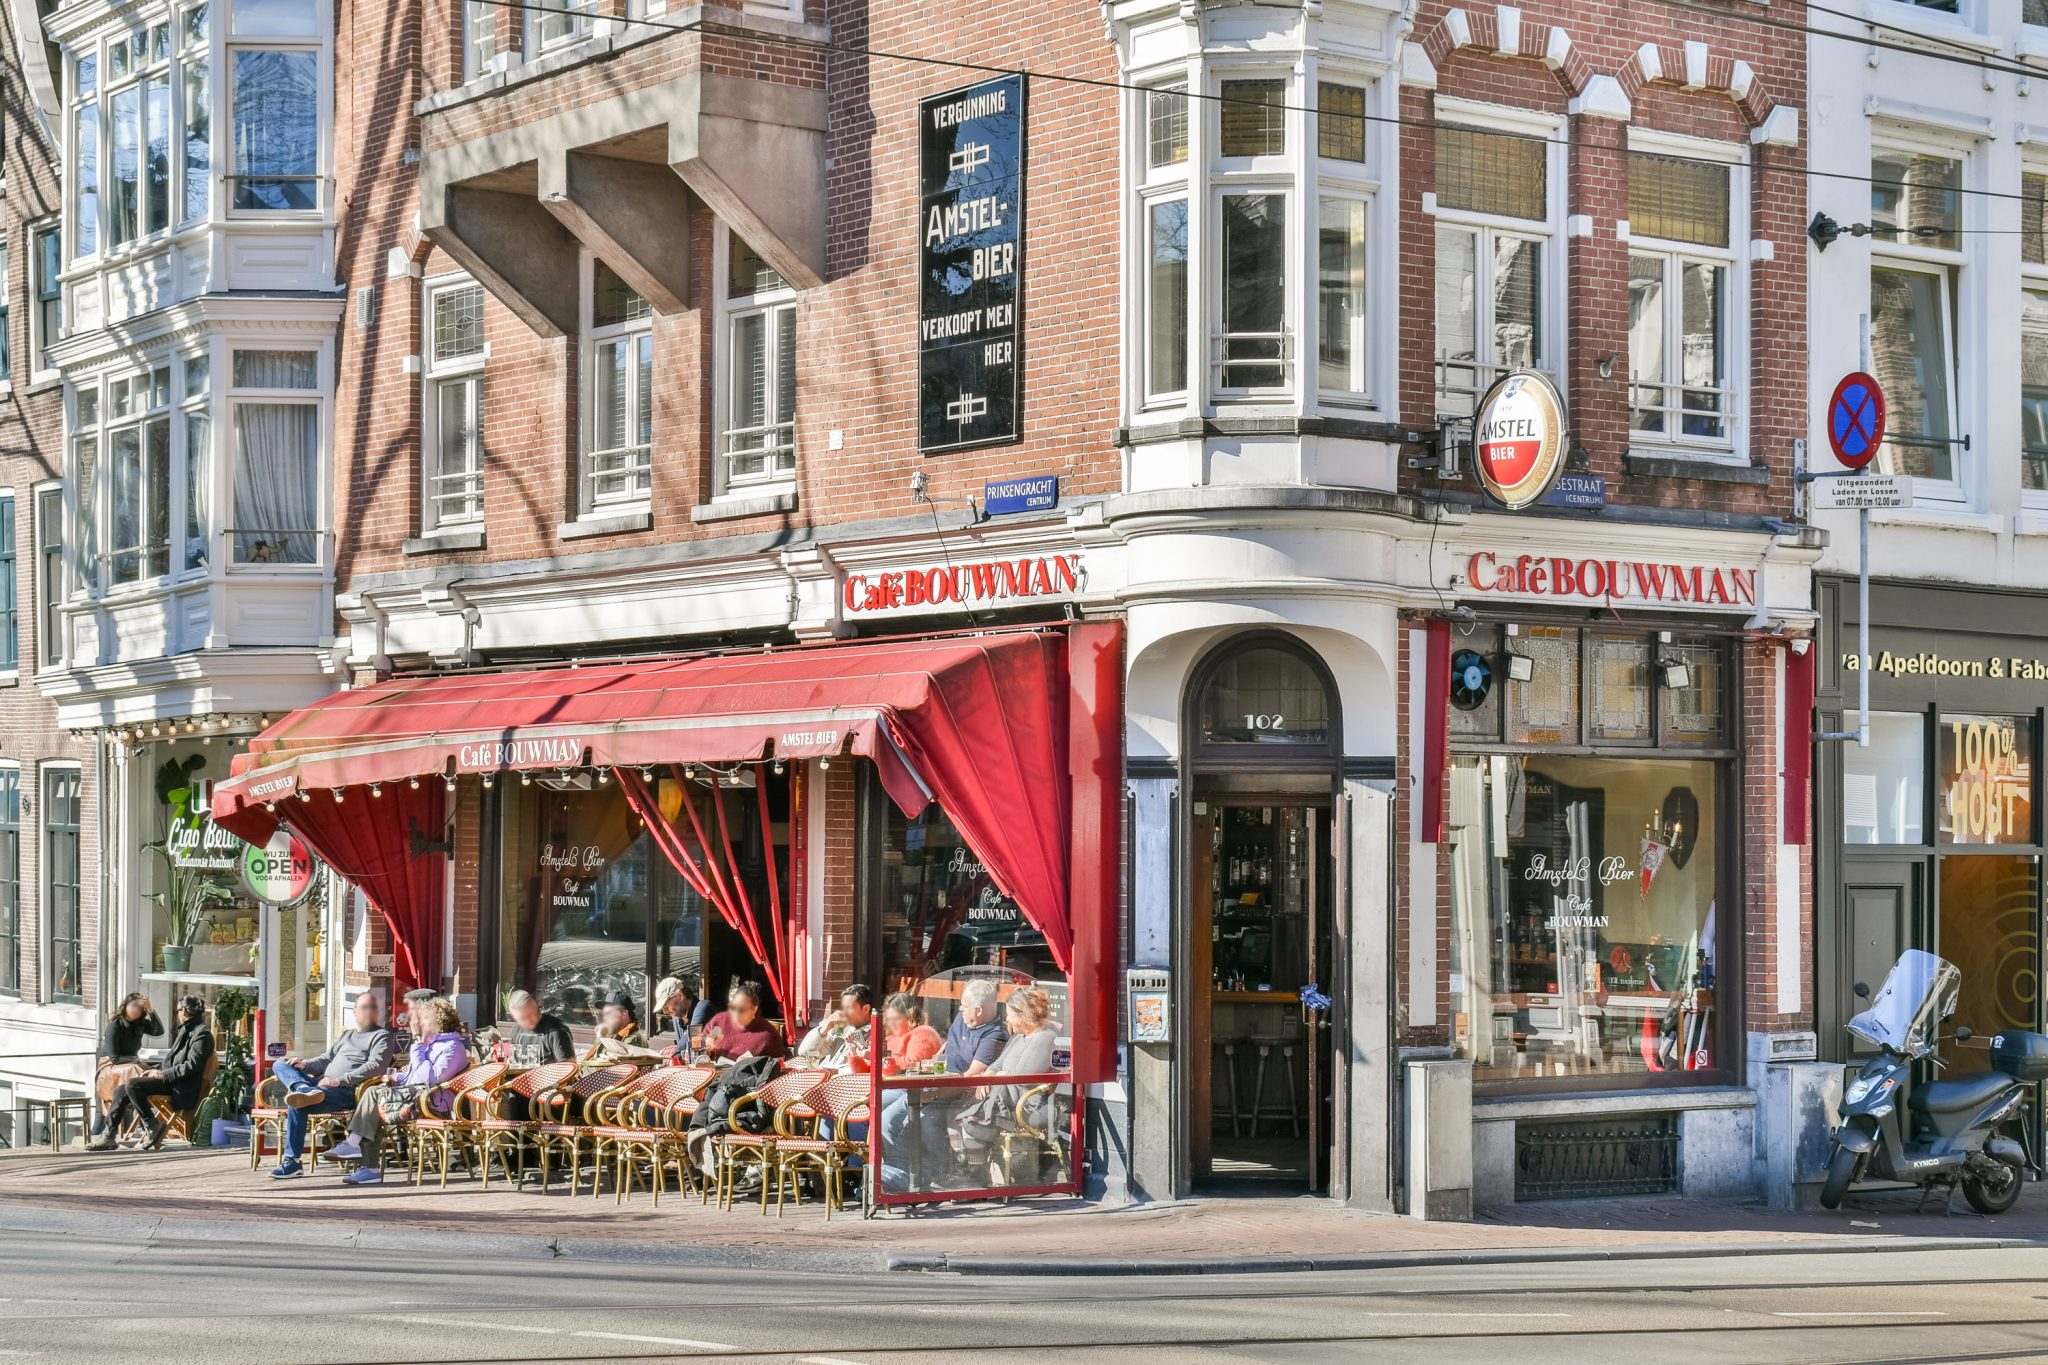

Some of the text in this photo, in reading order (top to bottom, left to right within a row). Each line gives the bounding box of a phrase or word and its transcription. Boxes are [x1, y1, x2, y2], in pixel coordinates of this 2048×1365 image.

[933, 89, 1006, 129] VERGUNNING
[925, 195, 1008, 248] AMSTEL-
[972, 242, 1014, 281] BIER
[921, 303, 1012, 342] VERKOOPT MEN
[984, 341, 1012, 367] HIER
[1480, 419, 1536, 441] AMSTEL
[1490, 446, 1515, 461] BIER
[987, 480, 1053, 500] PRINSENGRACHT
[1553, 477, 1601, 493] SESTRAAT
[1837, 478, 1893, 487] Uitgezonderd
[1026, 496, 1052, 507] CENTRUM
[1846, 497, 1863, 506] 07.00
[1874, 497, 1890, 506] 12.00
[844, 554, 1079, 612] Café BOUWMAN
[1468, 551, 1757, 607] Café BOUWMAN
[1879, 651, 1983, 678] Apeldoorn
[1989, 657, 2004, 678] &
[2010, 658, 2048, 680] Fab
[1243, 714, 1284, 730] 102
[781, 730, 838, 747] AMSTEL BIER
[1952, 720, 2018, 776] 100%
[460, 738, 581, 767] Café BOUWMAN
[274, 775, 293, 790] BIER
[1952, 781, 2018, 836] HOUT
[167, 818, 200, 856] Ciao
[250, 858, 307, 875] OPEN
[582, 845, 605, 872] Bier
[948, 847, 988, 880] Amste
[1598, 855, 1635, 887] Bier
[553, 895, 590, 908] BOUWMAN
[1566, 893, 1593, 916] Café
[968, 907, 1017, 921] BOUWMAN
[1549, 915, 1609, 928] BOUWMAN
[1913, 1159, 1939, 1168] KYMCO
